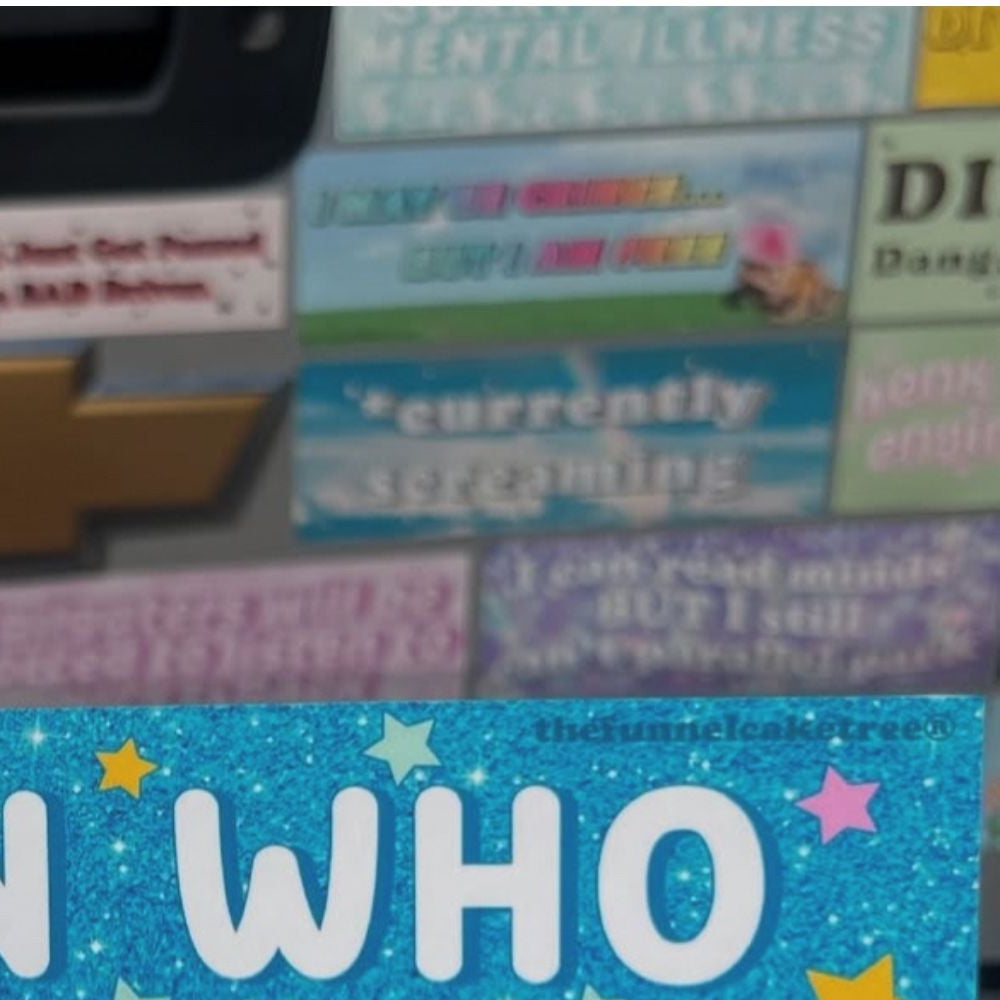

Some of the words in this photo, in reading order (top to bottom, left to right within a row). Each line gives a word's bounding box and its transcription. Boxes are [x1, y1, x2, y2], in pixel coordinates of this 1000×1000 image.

[361, 24, 600, 76] MENTAL
[624, 10, 890, 64] ILLNESS
[872, 242, 1000, 281] Dang
[173, 785, 766, 987] WHO
